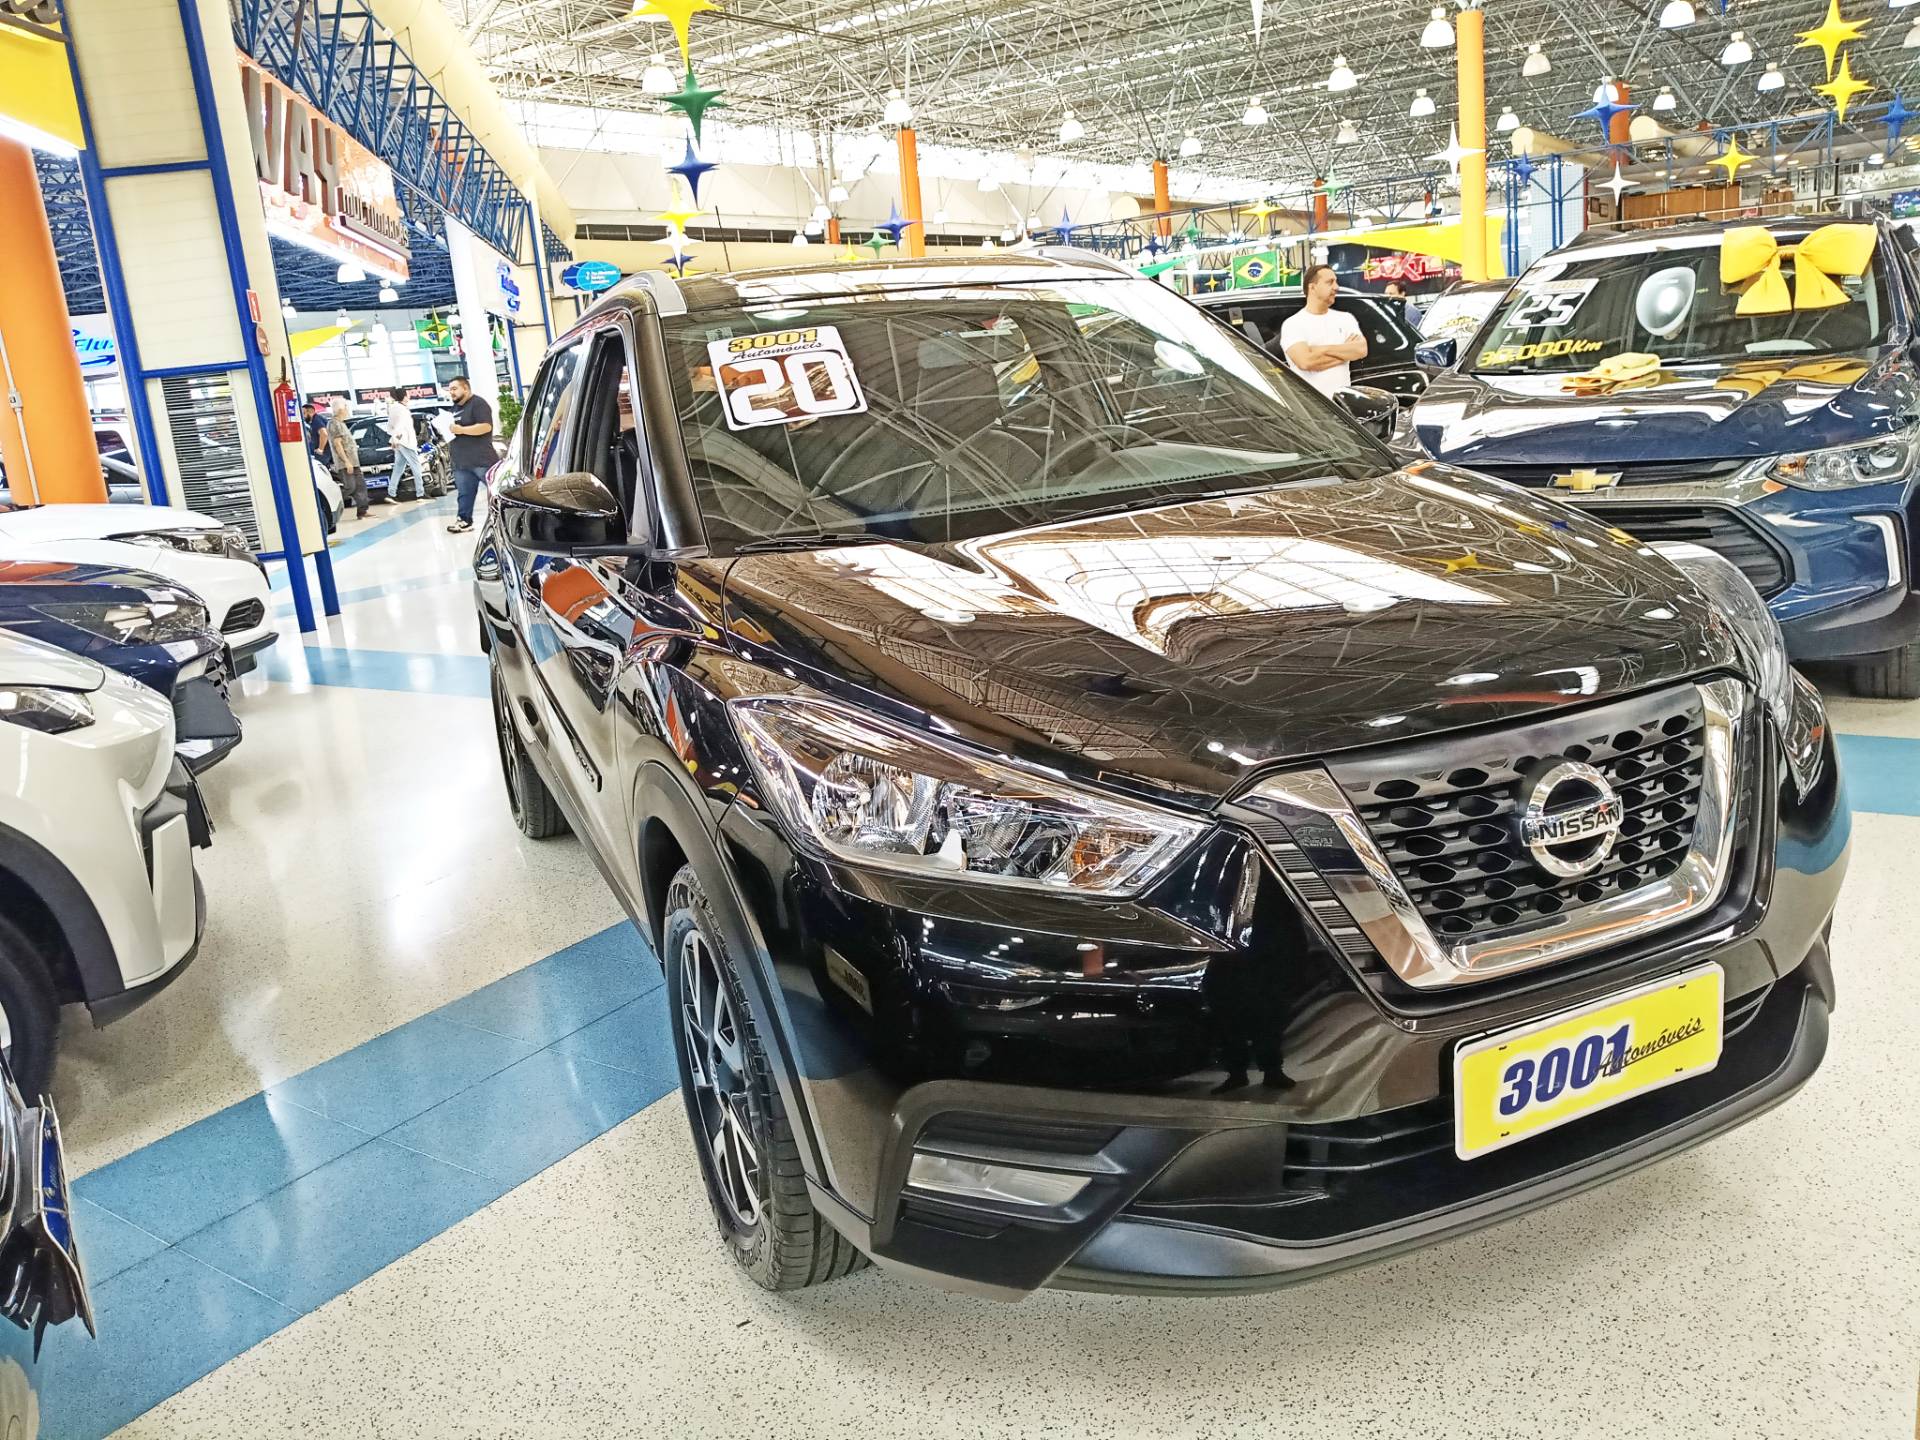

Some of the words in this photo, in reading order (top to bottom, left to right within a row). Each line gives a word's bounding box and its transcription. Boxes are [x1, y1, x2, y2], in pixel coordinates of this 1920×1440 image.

[1508, 293, 1583, 325] 25
[727, 328, 818, 353] 3001
[731, 341, 825, 362] Automóveis
[728, 350, 858, 425] 20
[1539, 806, 1620, 840] NISSAN
[1498, 1023, 1631, 1116] 3001
[1590, 1015, 1705, 1082] Automóveis
